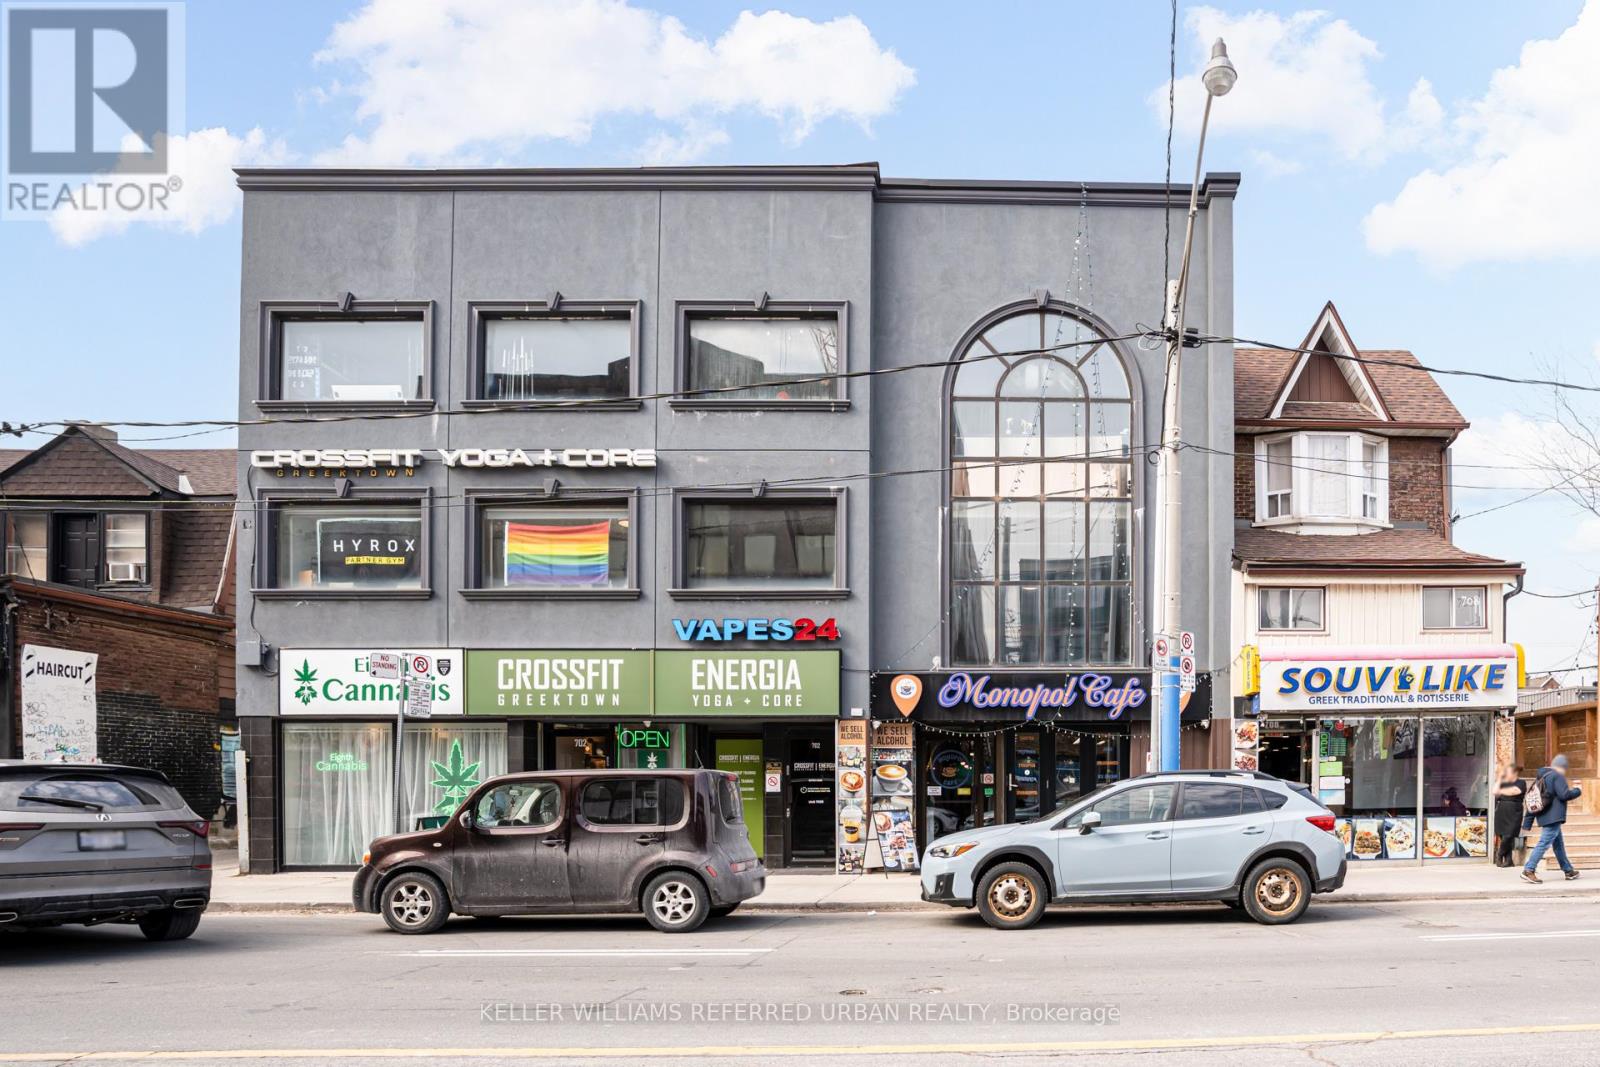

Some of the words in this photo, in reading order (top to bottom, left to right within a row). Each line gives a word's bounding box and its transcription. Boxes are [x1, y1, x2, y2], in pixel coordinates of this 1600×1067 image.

[251, 449, 422, 468] CROSSFIT
[437, 448, 534, 467] YOGA
[538, 448, 557, 466] +
[563, 448, 656, 467] CORE
[276, 469, 414, 477] GREEKTOWN
[333, 539, 415, 552] HYROX
[672, 618, 841, 641] VAPES24
[37, 661, 83, 679] HAIRCUT
[372, 661, 397, 670] STANDING
[497, 659, 624, 690] CROSSFIT
[691, 659, 802, 690] ENERGIA
[1278, 665, 1393, 695] SOUV
[1418, 663, 1508, 692] LIKE
[322, 676, 451, 701] Cannais
[497, 694, 620, 707] GREEKTOWN
[693, 695, 733, 707] YOGA
[762, 694, 803, 707] CORE
[938, 672, 1078, 721] Monopol
[1078, 673, 1147, 720] Cafe
[1308, 695, 1340, 704] GREEK
[1341, 693, 1405, 704] TRADITIONAL
[1408, 694, 1415, 703] &
[1416, 692, 1469, 702] ROTISSERIE
[877, 727, 888, 735] WE
[890, 726, 909, 735] SELL
[574, 739, 587, 747] 702
[620, 730, 669, 748] OPEN
[877, 737, 908, 745] ALCOHOL
[329, 753, 353, 763] Eighth
[316, 761, 368, 771] Cannabis
